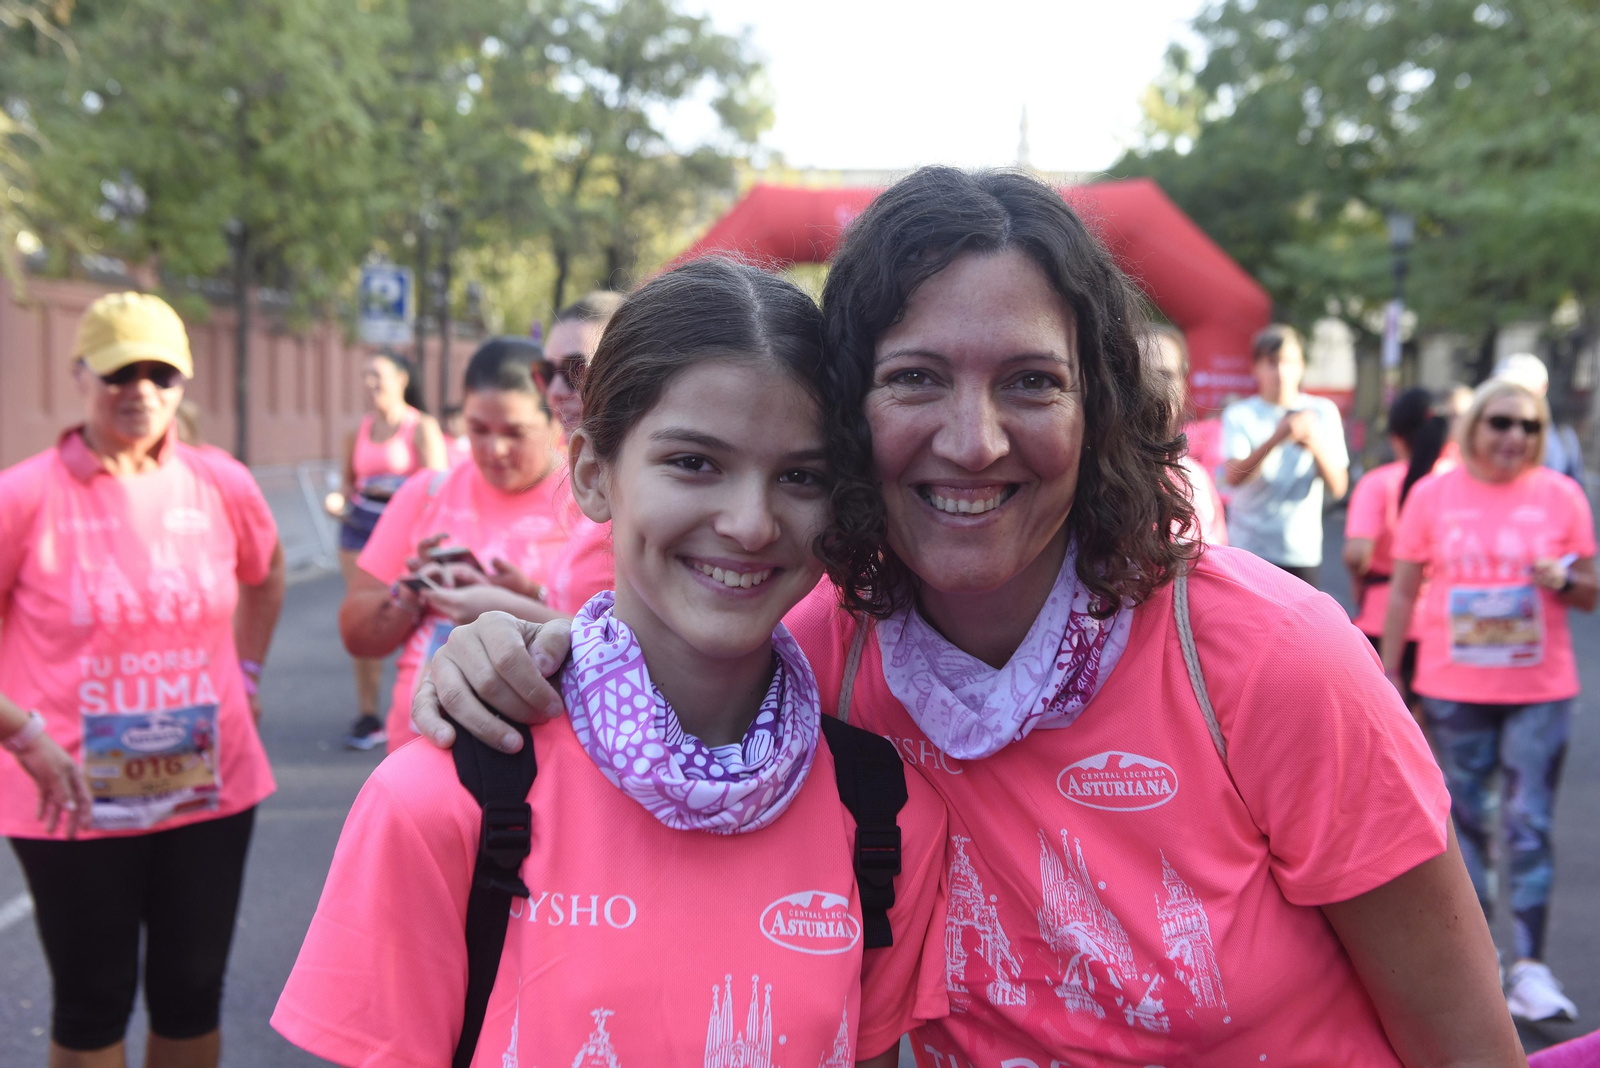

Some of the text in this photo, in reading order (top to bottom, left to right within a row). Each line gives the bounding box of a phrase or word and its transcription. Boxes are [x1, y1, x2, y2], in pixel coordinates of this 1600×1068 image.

[78, 655, 112, 677] TU
[79, 671, 219, 715] SUMA
[883, 735, 963, 775] YSHO
[125, 755, 183, 781] 016
[1081, 769, 1166, 779] CENTRAL LECHERA
[1067, 774, 1172, 796] ASTURIANA
[789, 909, 847, 920] CENTRAL LECH
